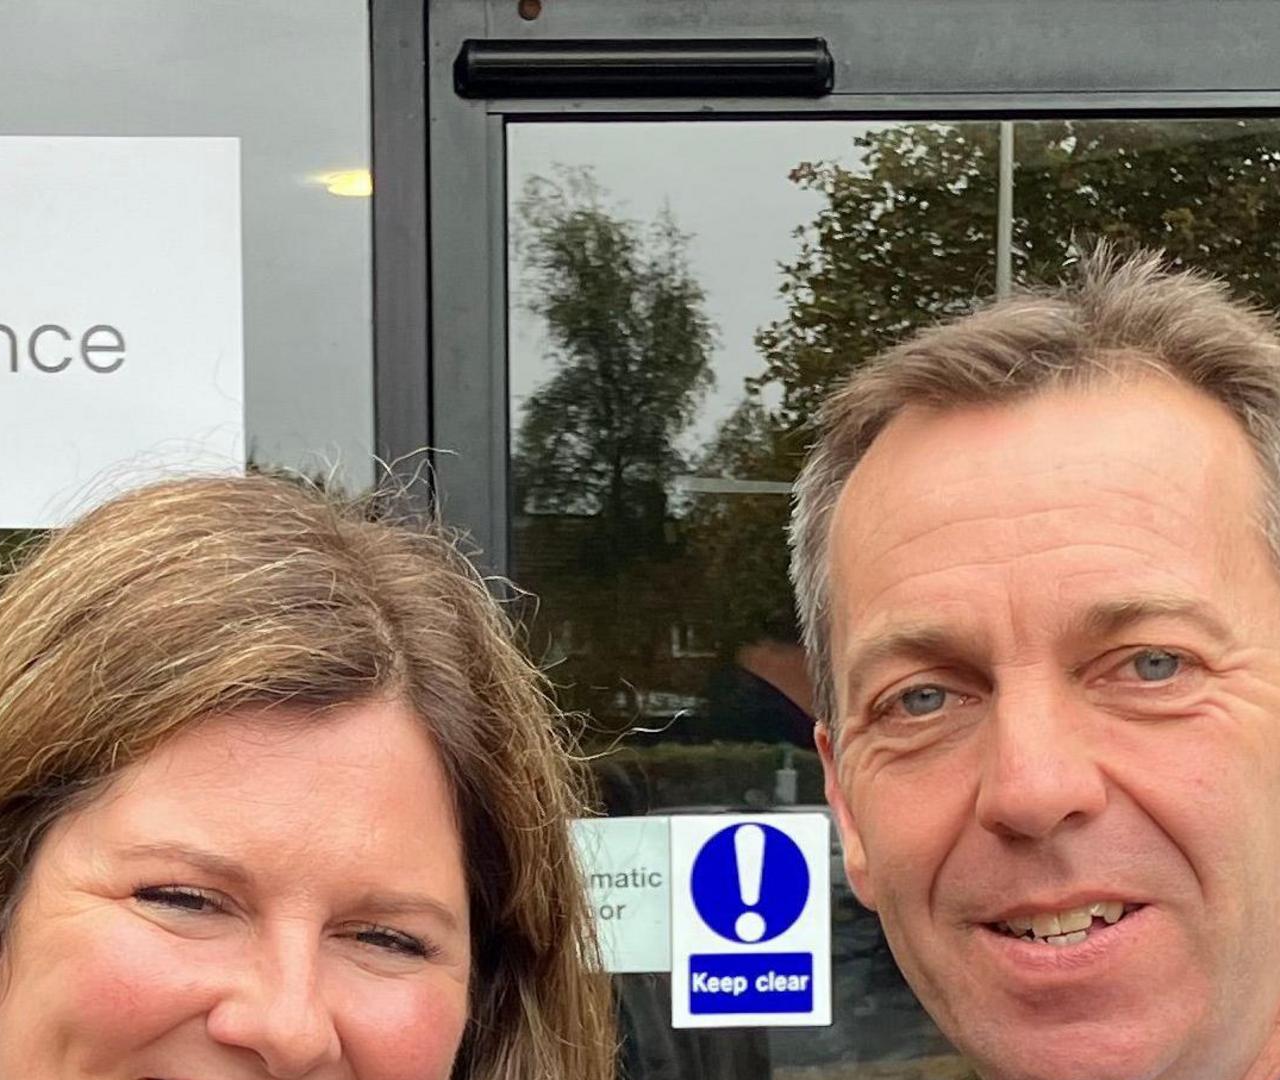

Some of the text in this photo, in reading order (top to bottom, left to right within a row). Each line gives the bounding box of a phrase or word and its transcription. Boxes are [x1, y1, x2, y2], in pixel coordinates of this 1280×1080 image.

[592, 868, 663, 888] matic
[599, 904, 626, 920] or
[692, 971, 809, 995] Keep clear
